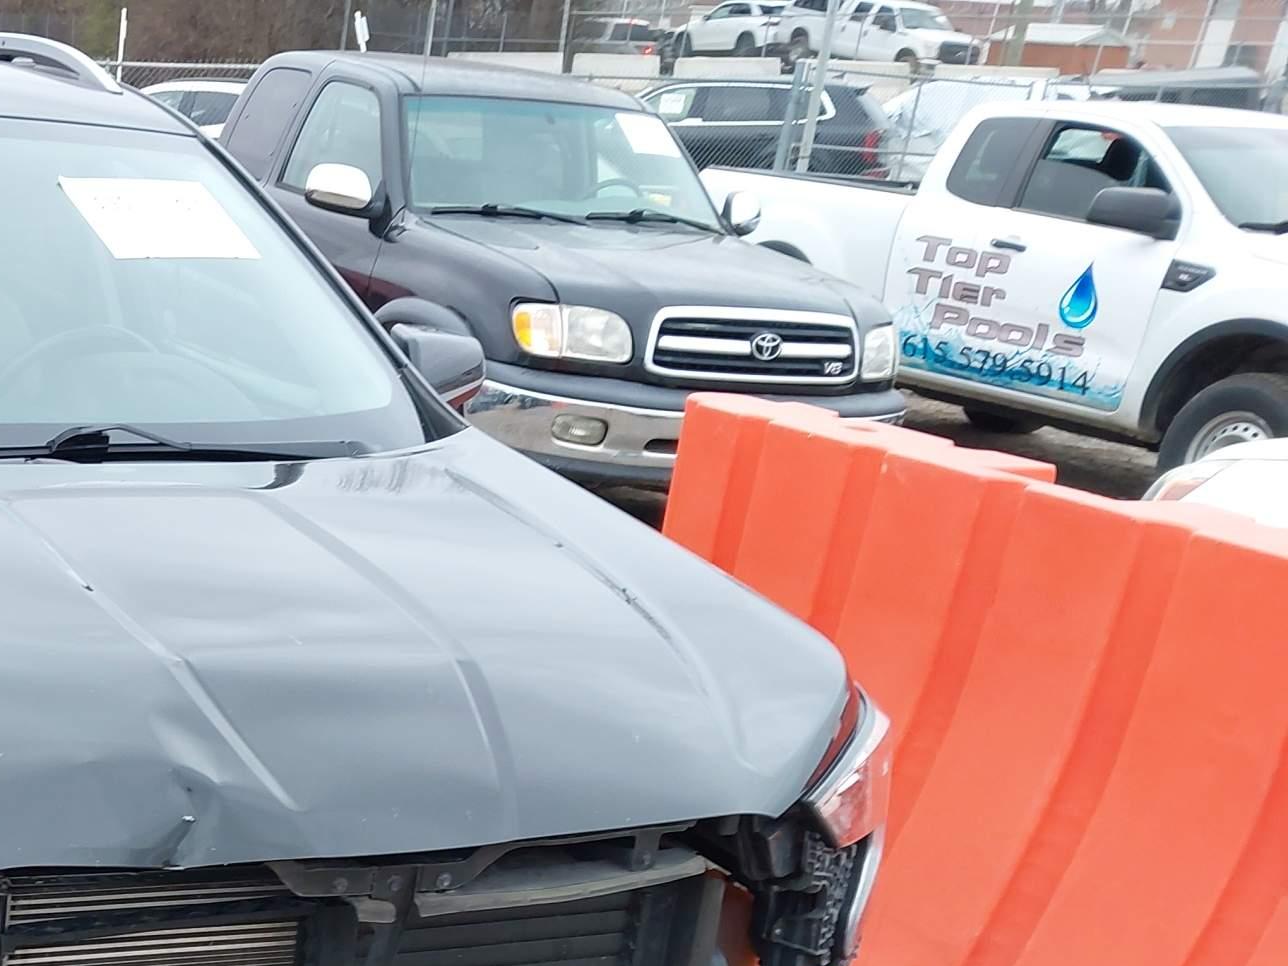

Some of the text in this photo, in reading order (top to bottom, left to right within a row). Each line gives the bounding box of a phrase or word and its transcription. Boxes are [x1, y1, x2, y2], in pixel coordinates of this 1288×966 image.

[915, 235, 1012, 278] Top
[906, 266, 1008, 307] Tier
[929, 302, 1087, 357] Pools
[823, 361, 843, 375] V8
[902, 333, 1090, 396] 615 579 5914
